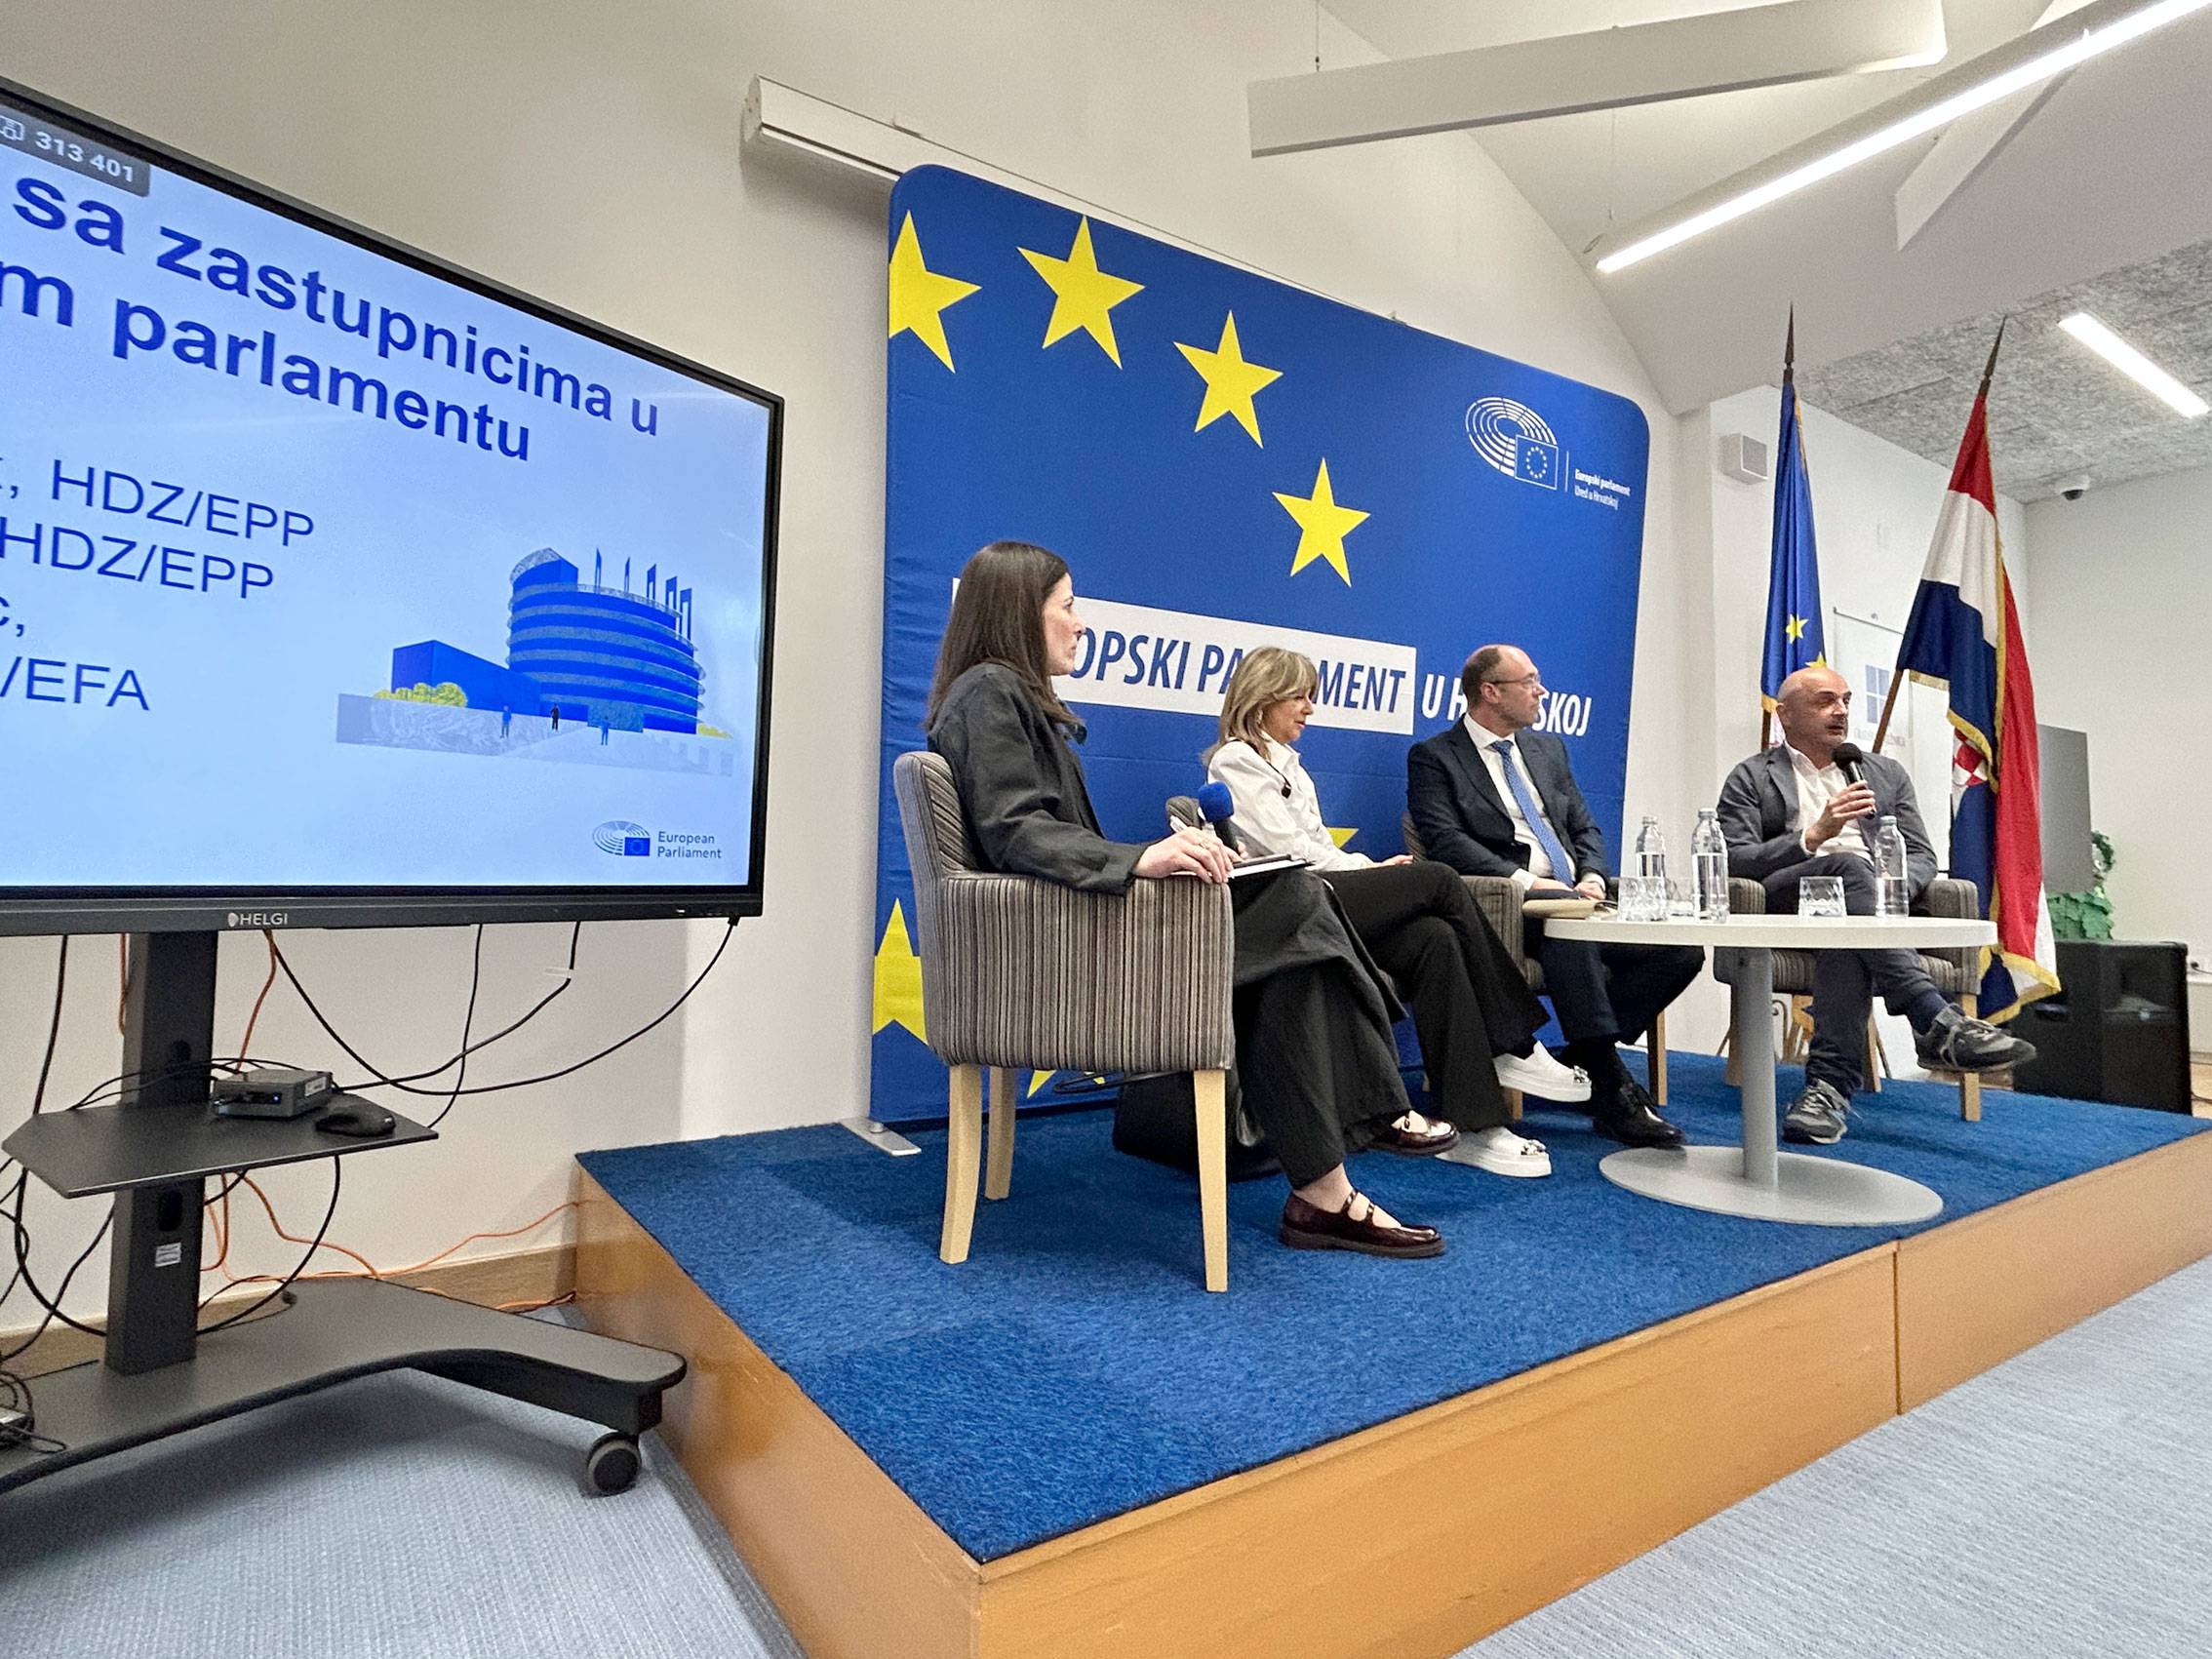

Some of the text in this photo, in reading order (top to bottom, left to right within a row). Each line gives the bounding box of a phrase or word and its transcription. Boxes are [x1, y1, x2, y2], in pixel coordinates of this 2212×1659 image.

[35, 131, 134, 182] 313 401
[13, 178, 657, 437] sa zastupnicima u
[113, 297, 529, 461] parlamentu
[52, 458, 314, 547] HDZ/EPP
[0, 516, 274, 599] HDZ/EPP
[1070, 627, 1592, 736] OPSKI PAMENT U HSKOJ
[657, 831, 715, 846] European
[657, 846, 723, 859] Parliament
[240, 913, 288, 926] HELGI
